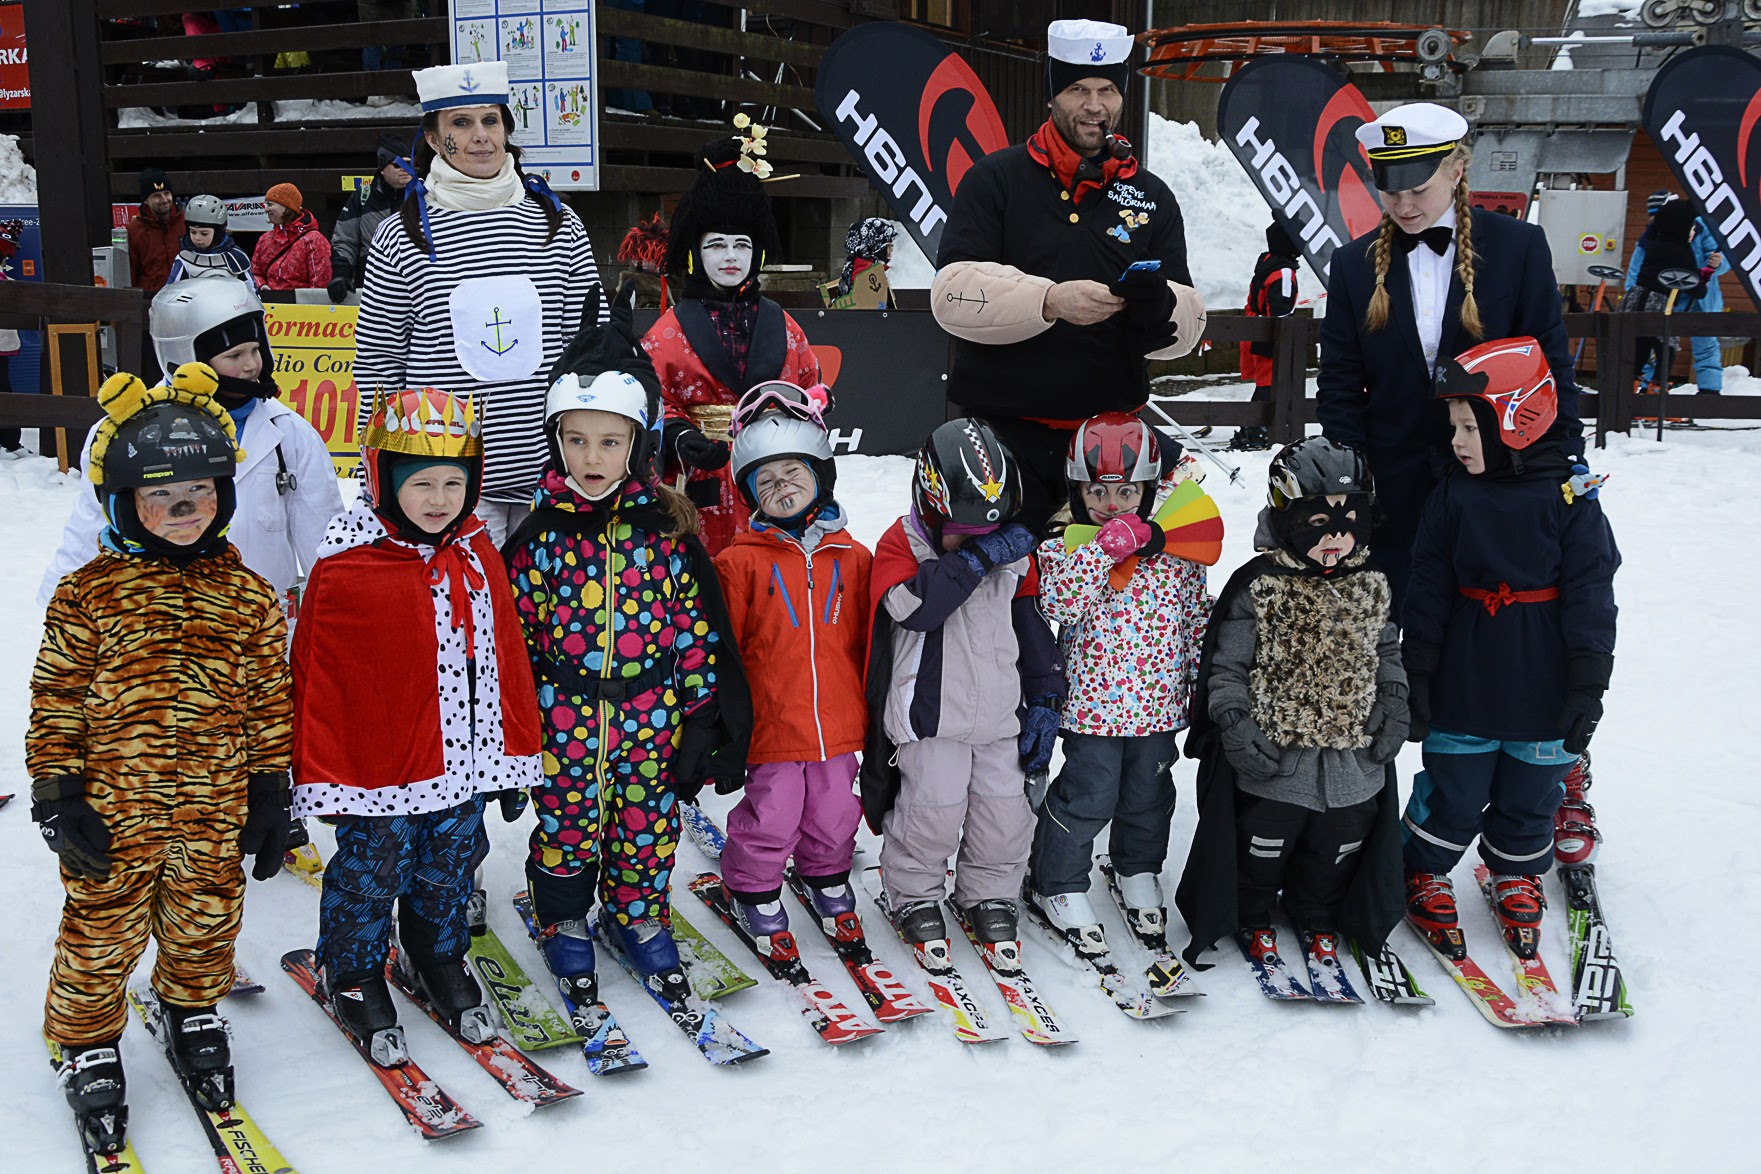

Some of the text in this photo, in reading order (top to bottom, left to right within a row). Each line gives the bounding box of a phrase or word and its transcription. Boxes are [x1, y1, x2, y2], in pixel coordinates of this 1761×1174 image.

[0, 48, 28, 65] RKA
[1107, 190, 1156, 211] SAILORMAN
[264, 313, 355, 338] formac
[273, 353, 305, 373] dio
[828, 427, 863, 452] H
[866, 964, 926, 1011] ATO
[804, 984, 873, 1031] ATO
[227, 1130, 269, 1174] FISCHE
